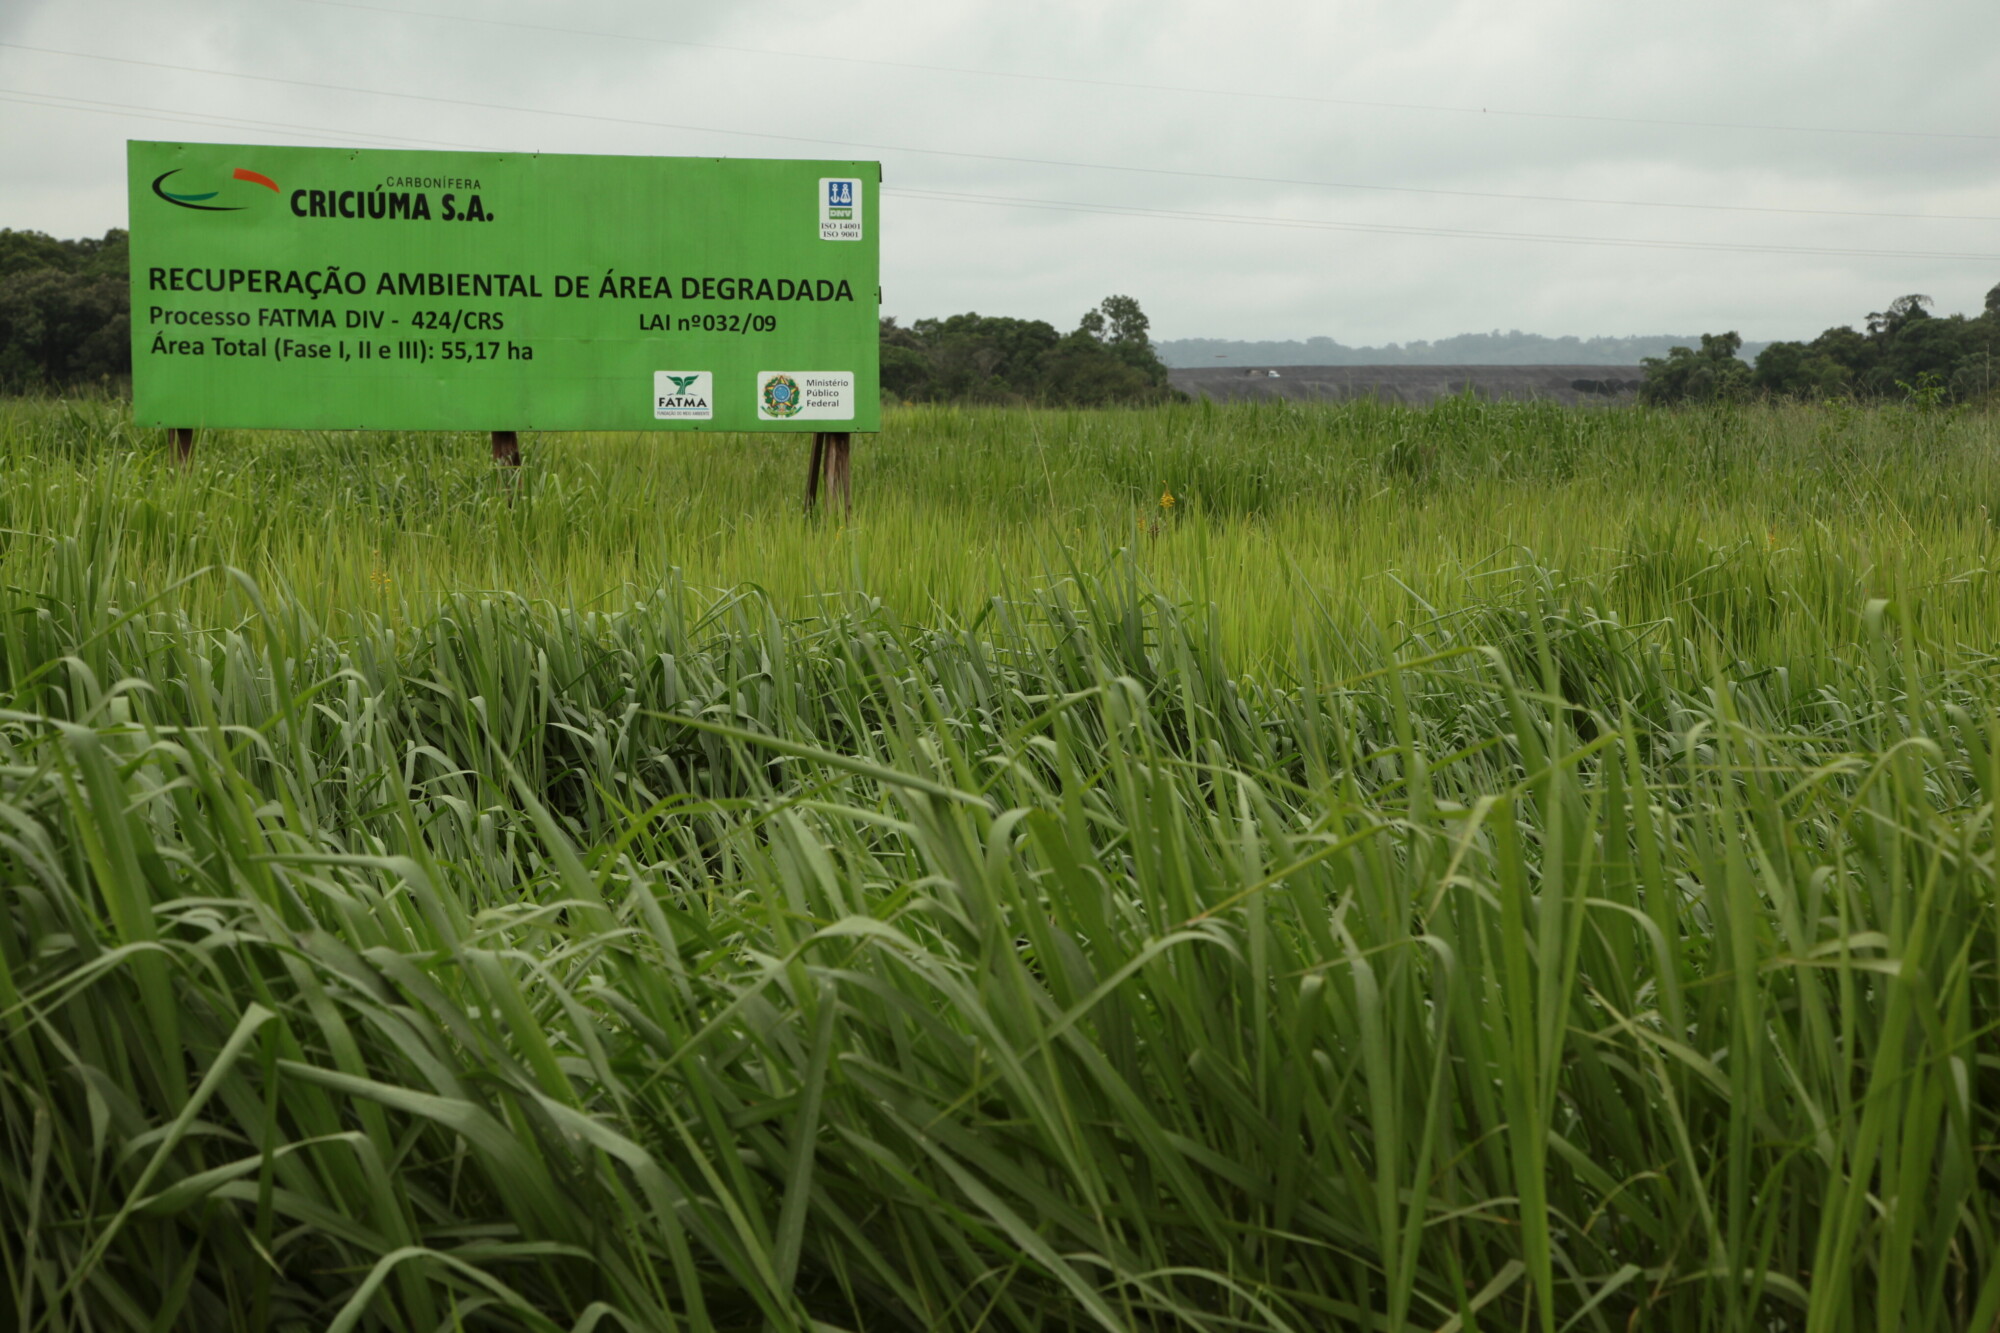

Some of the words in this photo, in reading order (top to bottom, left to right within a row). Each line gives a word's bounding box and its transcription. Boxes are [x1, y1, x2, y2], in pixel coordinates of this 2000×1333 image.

[386, 176, 482, 190] CARBONÍFERA
[290, 184, 432, 221] CRICIÚMA
[441, 193, 494, 222] S.A.
[830, 209, 851, 217] DNV
[149, 265, 367, 301] RECUPERAÇÃO
[376, 272, 543, 298] AMBIENTAL
[554, 275, 590, 299] DE
[598, 268, 673, 299] ÁREA
[681, 276, 854, 302] DEGRADADA
[149, 305, 251, 327] Processo
[258, 308, 337, 328] FATMA
[345, 309, 385, 329] DIV
[411, 309, 504, 334] 424/CRS
[639, 313, 671, 331] LAI
[150, 330, 205, 356] Área
[211, 337, 267, 357] Total
[274, 337, 332, 362] (Fase
[339, 340, 351, 362] I,
[358, 340, 371, 359] II
[378, 345, 391, 360] e
[398, 339, 434, 364] III):
[441, 341, 501, 364] 55,17
[507, 340, 533, 361] ha
[806, 379, 849, 387] Ministério
[806, 389, 839, 397] Público
[659, 397, 707, 407] FATMA
[806, 399, 840, 407] Federal
